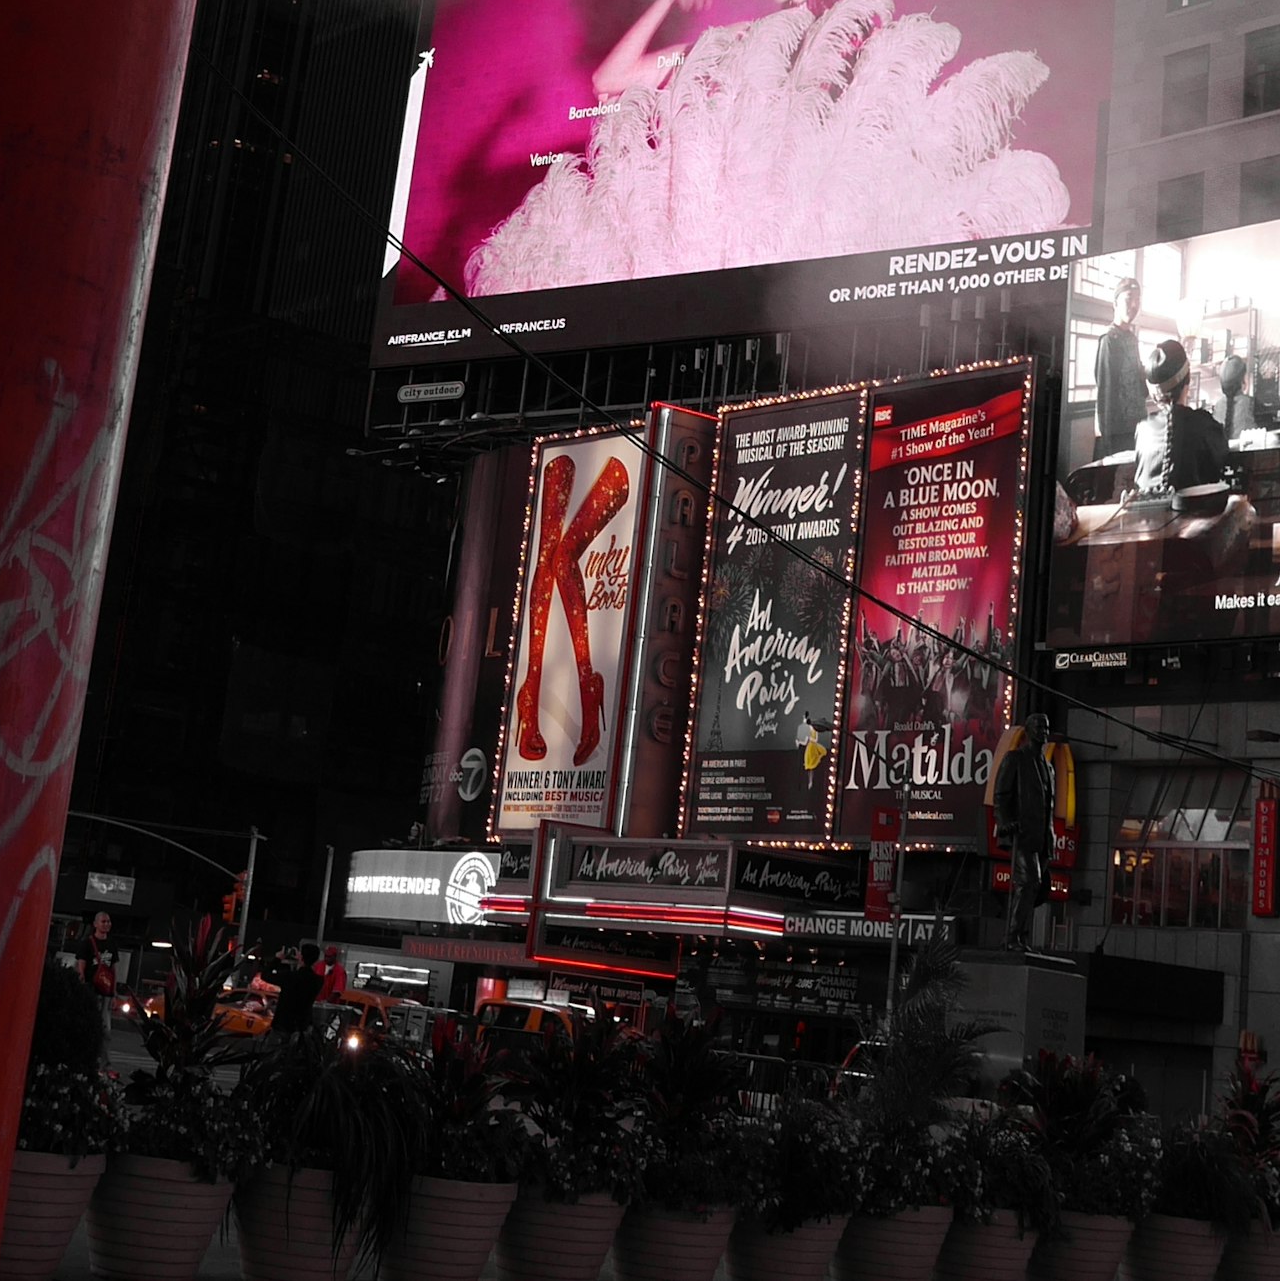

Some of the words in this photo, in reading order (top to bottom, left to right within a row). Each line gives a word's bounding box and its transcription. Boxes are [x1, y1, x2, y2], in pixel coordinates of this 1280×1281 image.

[657, 52, 686, 69] Delhi
[568, 100, 621, 121] Barcelona
[530, 150, 564, 168] Venice
[888, 238, 1055, 277] RENDEZ-VOUS
[1061, 235, 1088, 257] IN
[828, 287, 851, 304] OR
[853, 282, 896, 301] MORE
[899, 277, 944, 296] THAN
[947, 272, 991, 294] 1,000
[992, 266, 1046, 286] OTHER
[387, 330, 445, 346] AIRFRANCE
[447, 328, 472, 340] KLM
[403, 388, 422, 399] city
[423, 384, 460, 397] outdoor
[735, 433, 751, 449] THE
[751, 428, 777, 445] MOST
[776, 417, 850, 442] AWARD-WINNING
[900, 423, 927, 442] TIME
[928, 409, 987, 435] Magazine's
[737, 445, 774, 465] MUSICAL
[775, 443, 788, 459] OF
[789, 440, 807, 456] THE
[806, 434, 845, 455] SEASON!
[891, 446, 904, 461] #1
[905, 440, 933, 458] Show
[935, 435, 948, 449] of
[948, 431, 966, 446] the
[967, 422, 995, 439] Year!
[955, 459, 975, 480] IN
[727, 462, 848, 523] Winner!
[882, 491, 896, 510] A
[899, 483, 940, 507] BLUE
[942, 477, 1001, 502] MOON,
[900, 510, 909, 522] A
[909, 505, 941, 521] SHOW
[942, 501, 978, 516] COMES
[726, 523, 745, 555] 4
[746, 527, 768, 546] 2015
[770, 522, 797, 543] TONY
[797, 518, 840, 541] AWARDS
[892, 523, 915, 537] OUT
[915, 518, 959, 534] BLAZING
[960, 515, 984, 530] AND
[897, 535, 947, 551] RESTORES
[948, 532, 976, 546] YOUR
[884, 552, 914, 567] FAITH
[915, 551, 927, 564] IN
[928, 545, 990, 563] BROADWAY.
[911, 563, 959, 579] MATILDA
[584, 579, 628, 611] Boots
[648, 435, 702, 743] PALACE
[896, 583, 906, 595] IS
[907, 580, 934, 594] THAT
[1214, 593, 1255, 610] Makes
[1256, 591, 1266, 607] it
[744, 587, 773, 639] An
[724, 624, 824, 685] American
[735, 669, 800, 718] Paris
[893, 720, 914, 732] Roald
[913, 720, 936, 732] Dahl's
[845, 722, 994, 791] Matilda
[448, 765, 464, 783] abc
[506, 771, 542, 790] WINNER!
[544, 771, 551, 789] 6
[552, 770, 576, 789] TONY
[505, 791, 544, 802] INCLUDING
[544, 791, 568, 802] BEST
[910, 788, 943, 801] MUSICAL
[577, 849, 595, 869] An
[595, 844, 654, 882] American
[658, 851, 691, 885] Paris
[740, 859, 758, 884] An
[758, 861, 812, 897] American
[784, 917, 846, 937] CHANGE
[848, 919, 905, 939] MONEY
[820, 975, 858, 989] CHANGE
[820, 987, 857, 1002] MONEY
